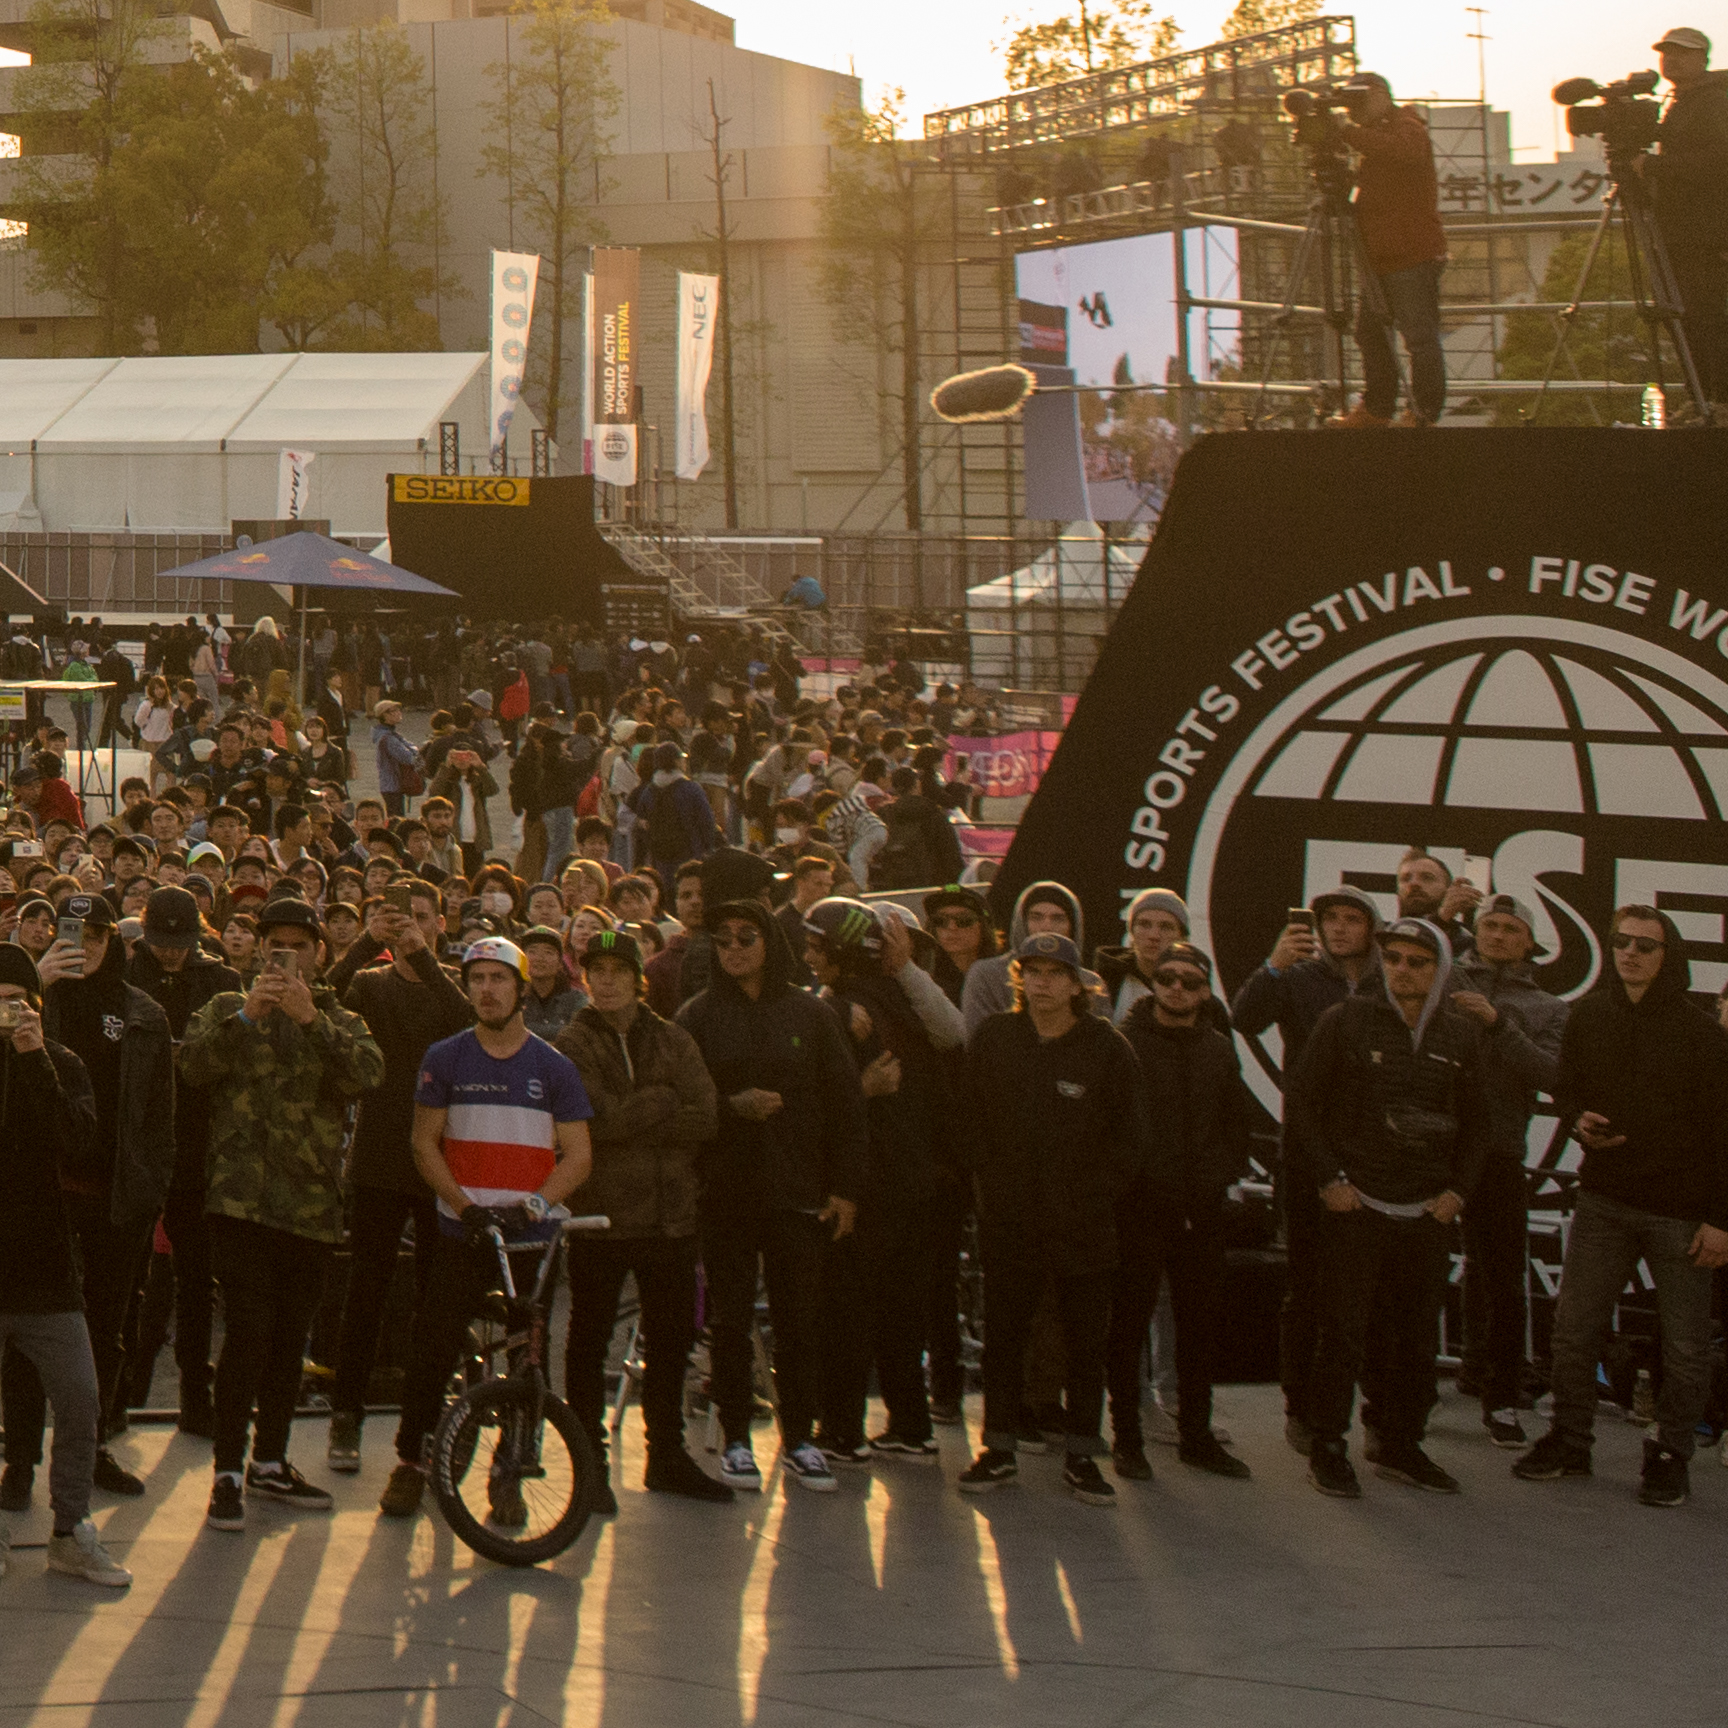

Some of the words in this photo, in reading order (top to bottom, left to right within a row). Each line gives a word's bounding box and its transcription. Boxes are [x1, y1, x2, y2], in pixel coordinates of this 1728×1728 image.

[617, 301, 630, 361] FESTIVAL
[692, 283, 708, 340] NEC
[604, 314, 616, 365] ACTION
[604, 367, 615, 415] WORLD
[616, 364, 629, 414] SPORTS
[405, 476, 519, 503] SEIKO
[1125, 684, 1242, 874] SPORTS
[1229, 561, 1472, 691] FESTIVAL
[1528, 555, 1657, 615] FISE
